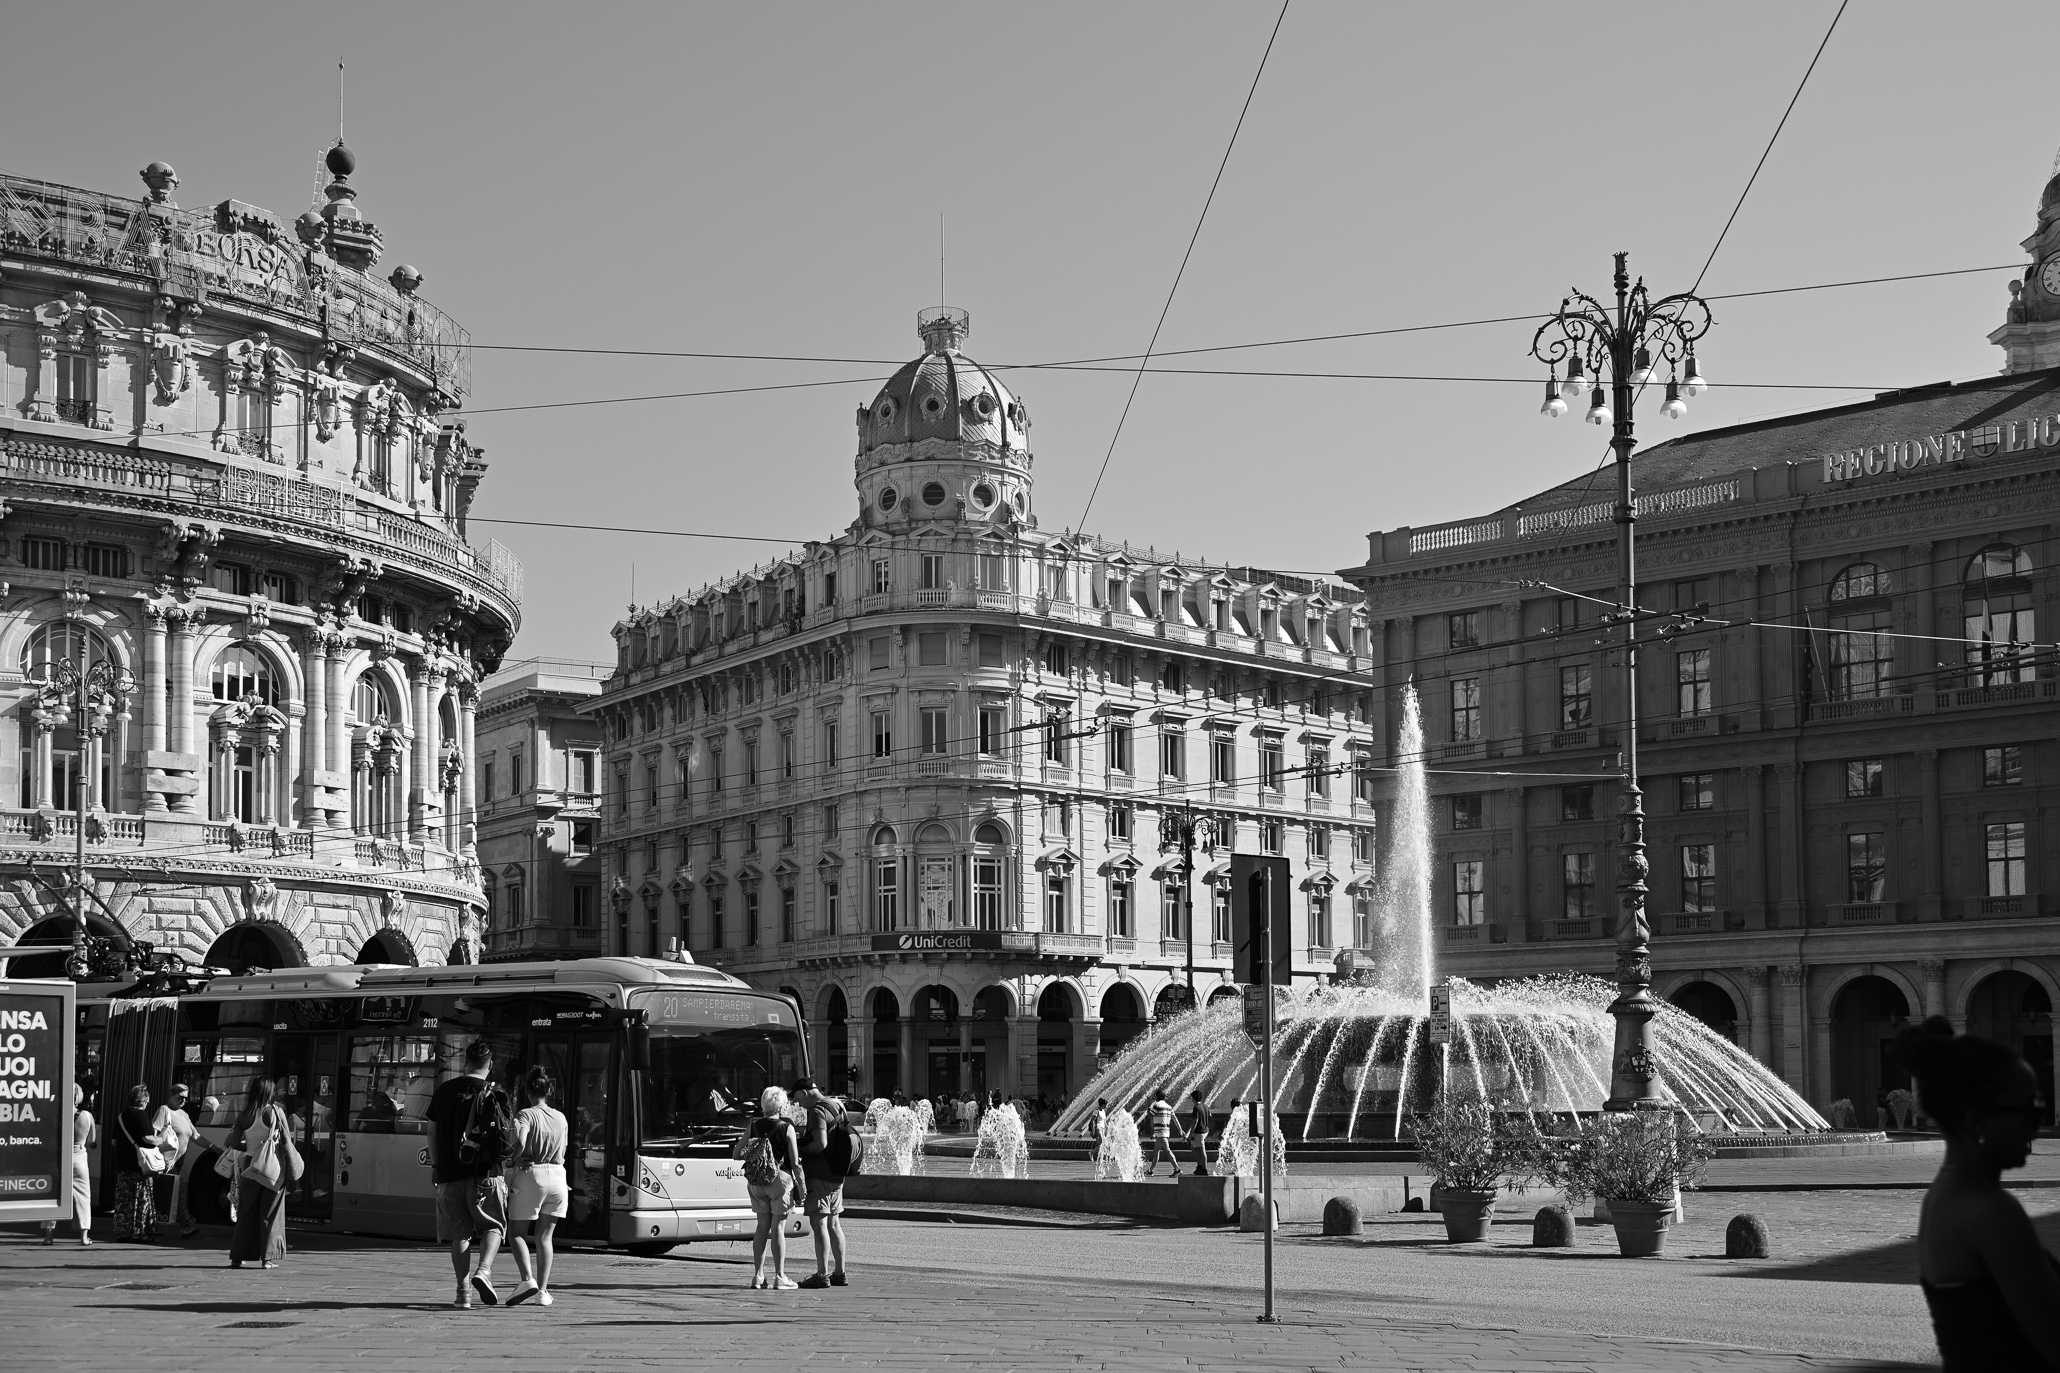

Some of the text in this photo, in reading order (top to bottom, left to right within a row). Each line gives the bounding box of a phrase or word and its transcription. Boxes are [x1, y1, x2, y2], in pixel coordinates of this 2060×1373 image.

[196, 232, 294, 283] BORSA
[1822, 430, 1965, 483] REGIONE
[914, 935, 971, 948] UniCredit
[664, 997, 678, 1018] 20
[0, 1010, 48, 1030] NSA
[273, 1022, 287, 1030] uscita
[423, 1018, 438, 1028] 2112
[532, 1018, 552, 1027] entrata
[0, 1080, 55, 1102] AGNI,
[0, 1103, 41, 1122] BIA.
[10, 1135, 43, 1145] banca.
